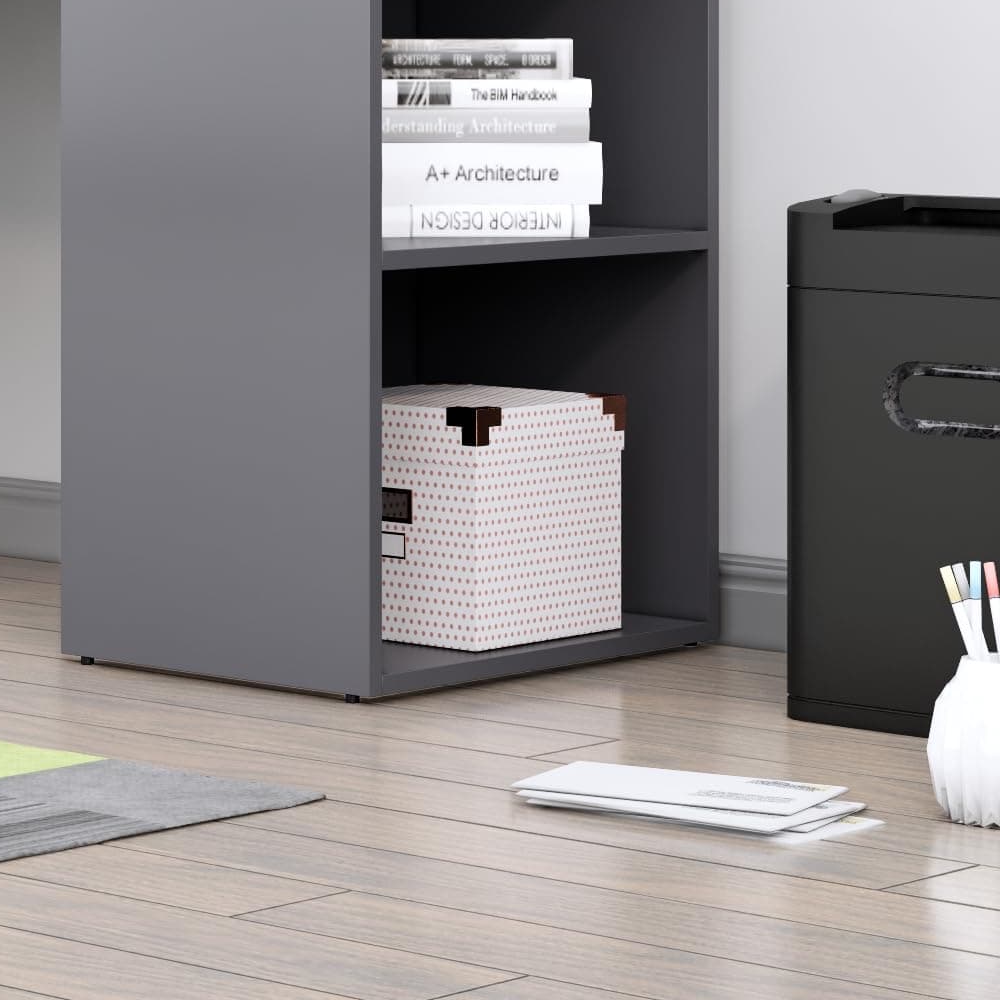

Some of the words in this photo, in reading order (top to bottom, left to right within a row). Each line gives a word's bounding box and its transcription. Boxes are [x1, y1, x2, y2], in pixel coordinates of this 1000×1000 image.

[471, 88, 488, 101] The
[490, 88, 508, 101] BIM
[511, 87, 557, 101] Handbook
[470, 116, 557, 135] Architecture
[425, 164, 450, 182] A+
[455, 164, 560, 182] Architecture
[420, 211, 483, 230] DESIGN
[489, 211, 562, 230] INTERIOR
